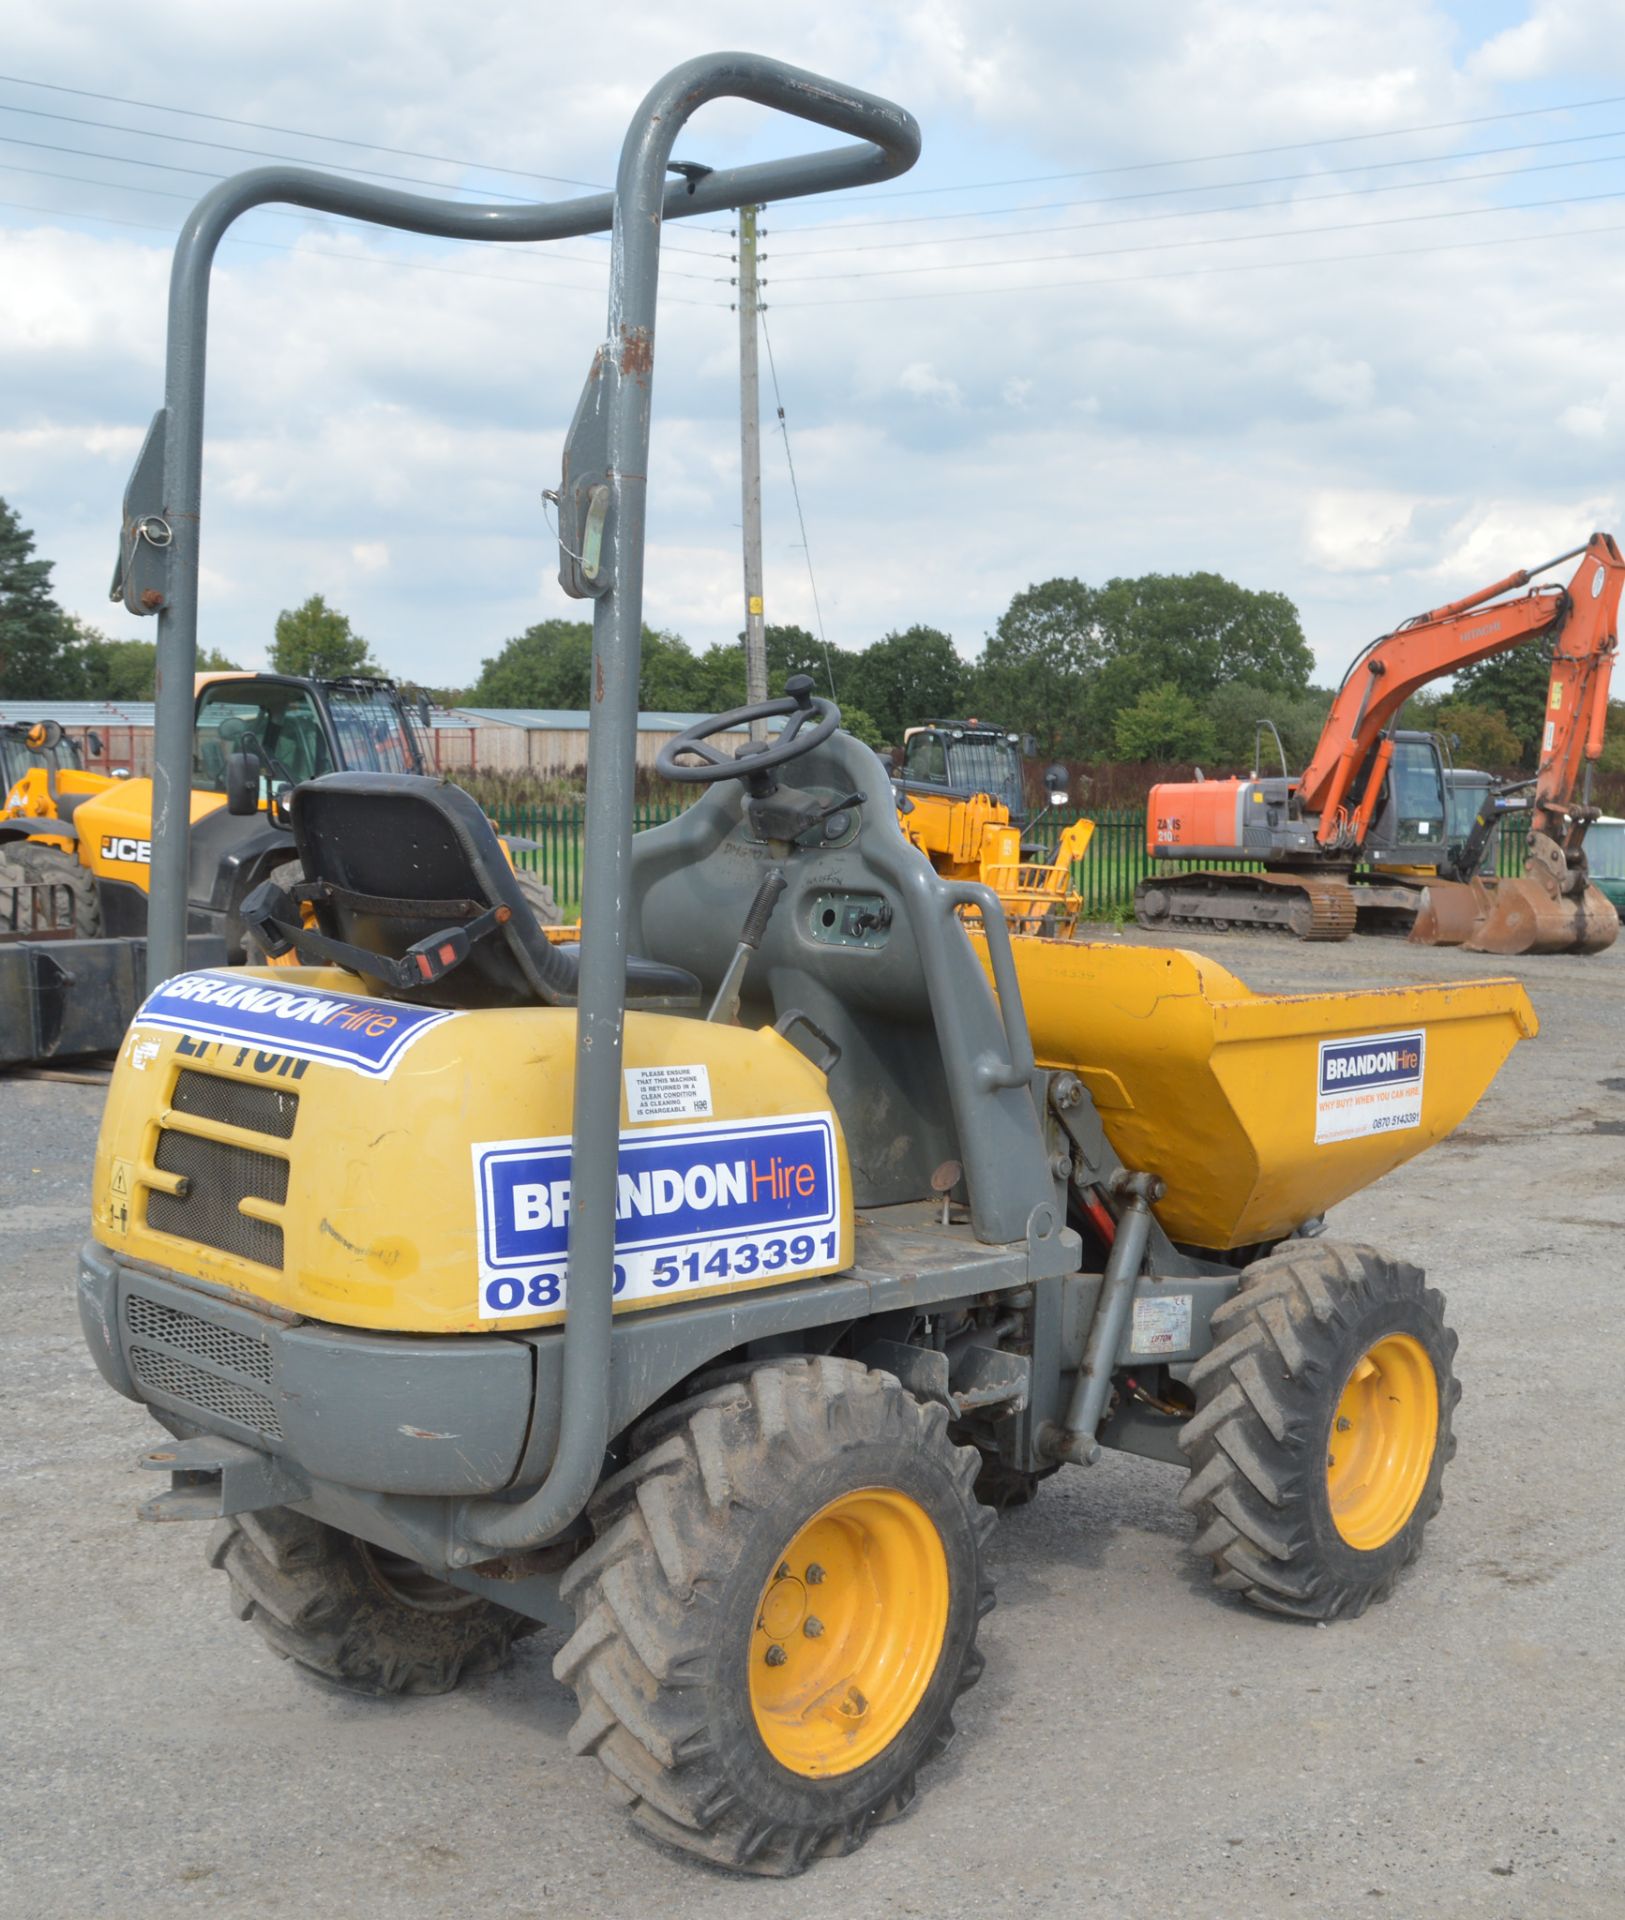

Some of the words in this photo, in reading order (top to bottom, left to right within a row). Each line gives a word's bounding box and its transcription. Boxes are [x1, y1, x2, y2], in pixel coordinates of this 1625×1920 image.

[648, 1084, 681, 1092] RETURNED
[663, 1091, 697, 1099] CONDITION
[645, 1107, 686, 1115] CHARGEABLE
[1373, 1117, 1391, 1130] 0870
[651, 1231, 837, 1288] 5143391
